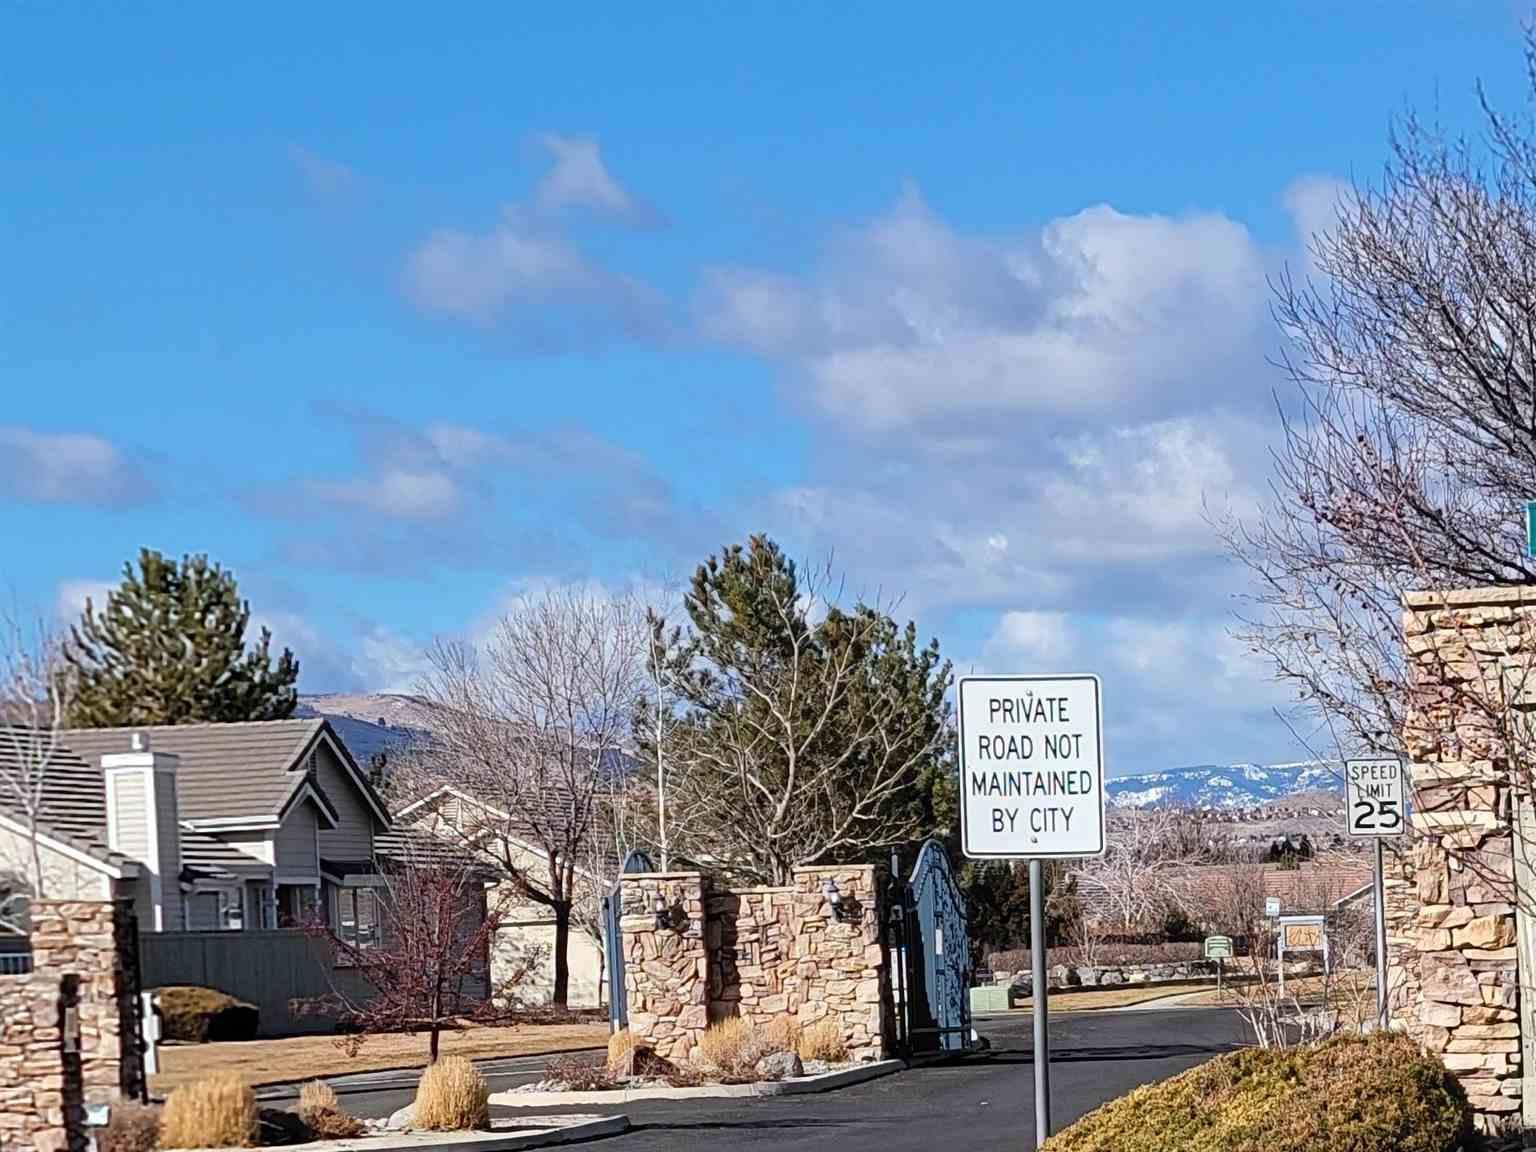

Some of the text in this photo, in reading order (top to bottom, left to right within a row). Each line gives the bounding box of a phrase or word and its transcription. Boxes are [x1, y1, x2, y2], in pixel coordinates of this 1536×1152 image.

[989, 697, 1070, 724] PRIVATE
[979, 733, 1082, 760] ROAD NOT
[972, 770, 1092, 797] MAINTAINED
[1352, 765, 1397, 780] SPEED
[1357, 783, 1393, 798] LIMIT
[992, 806, 1074, 833] BY CITY
[1354, 801, 1400, 828] 25
